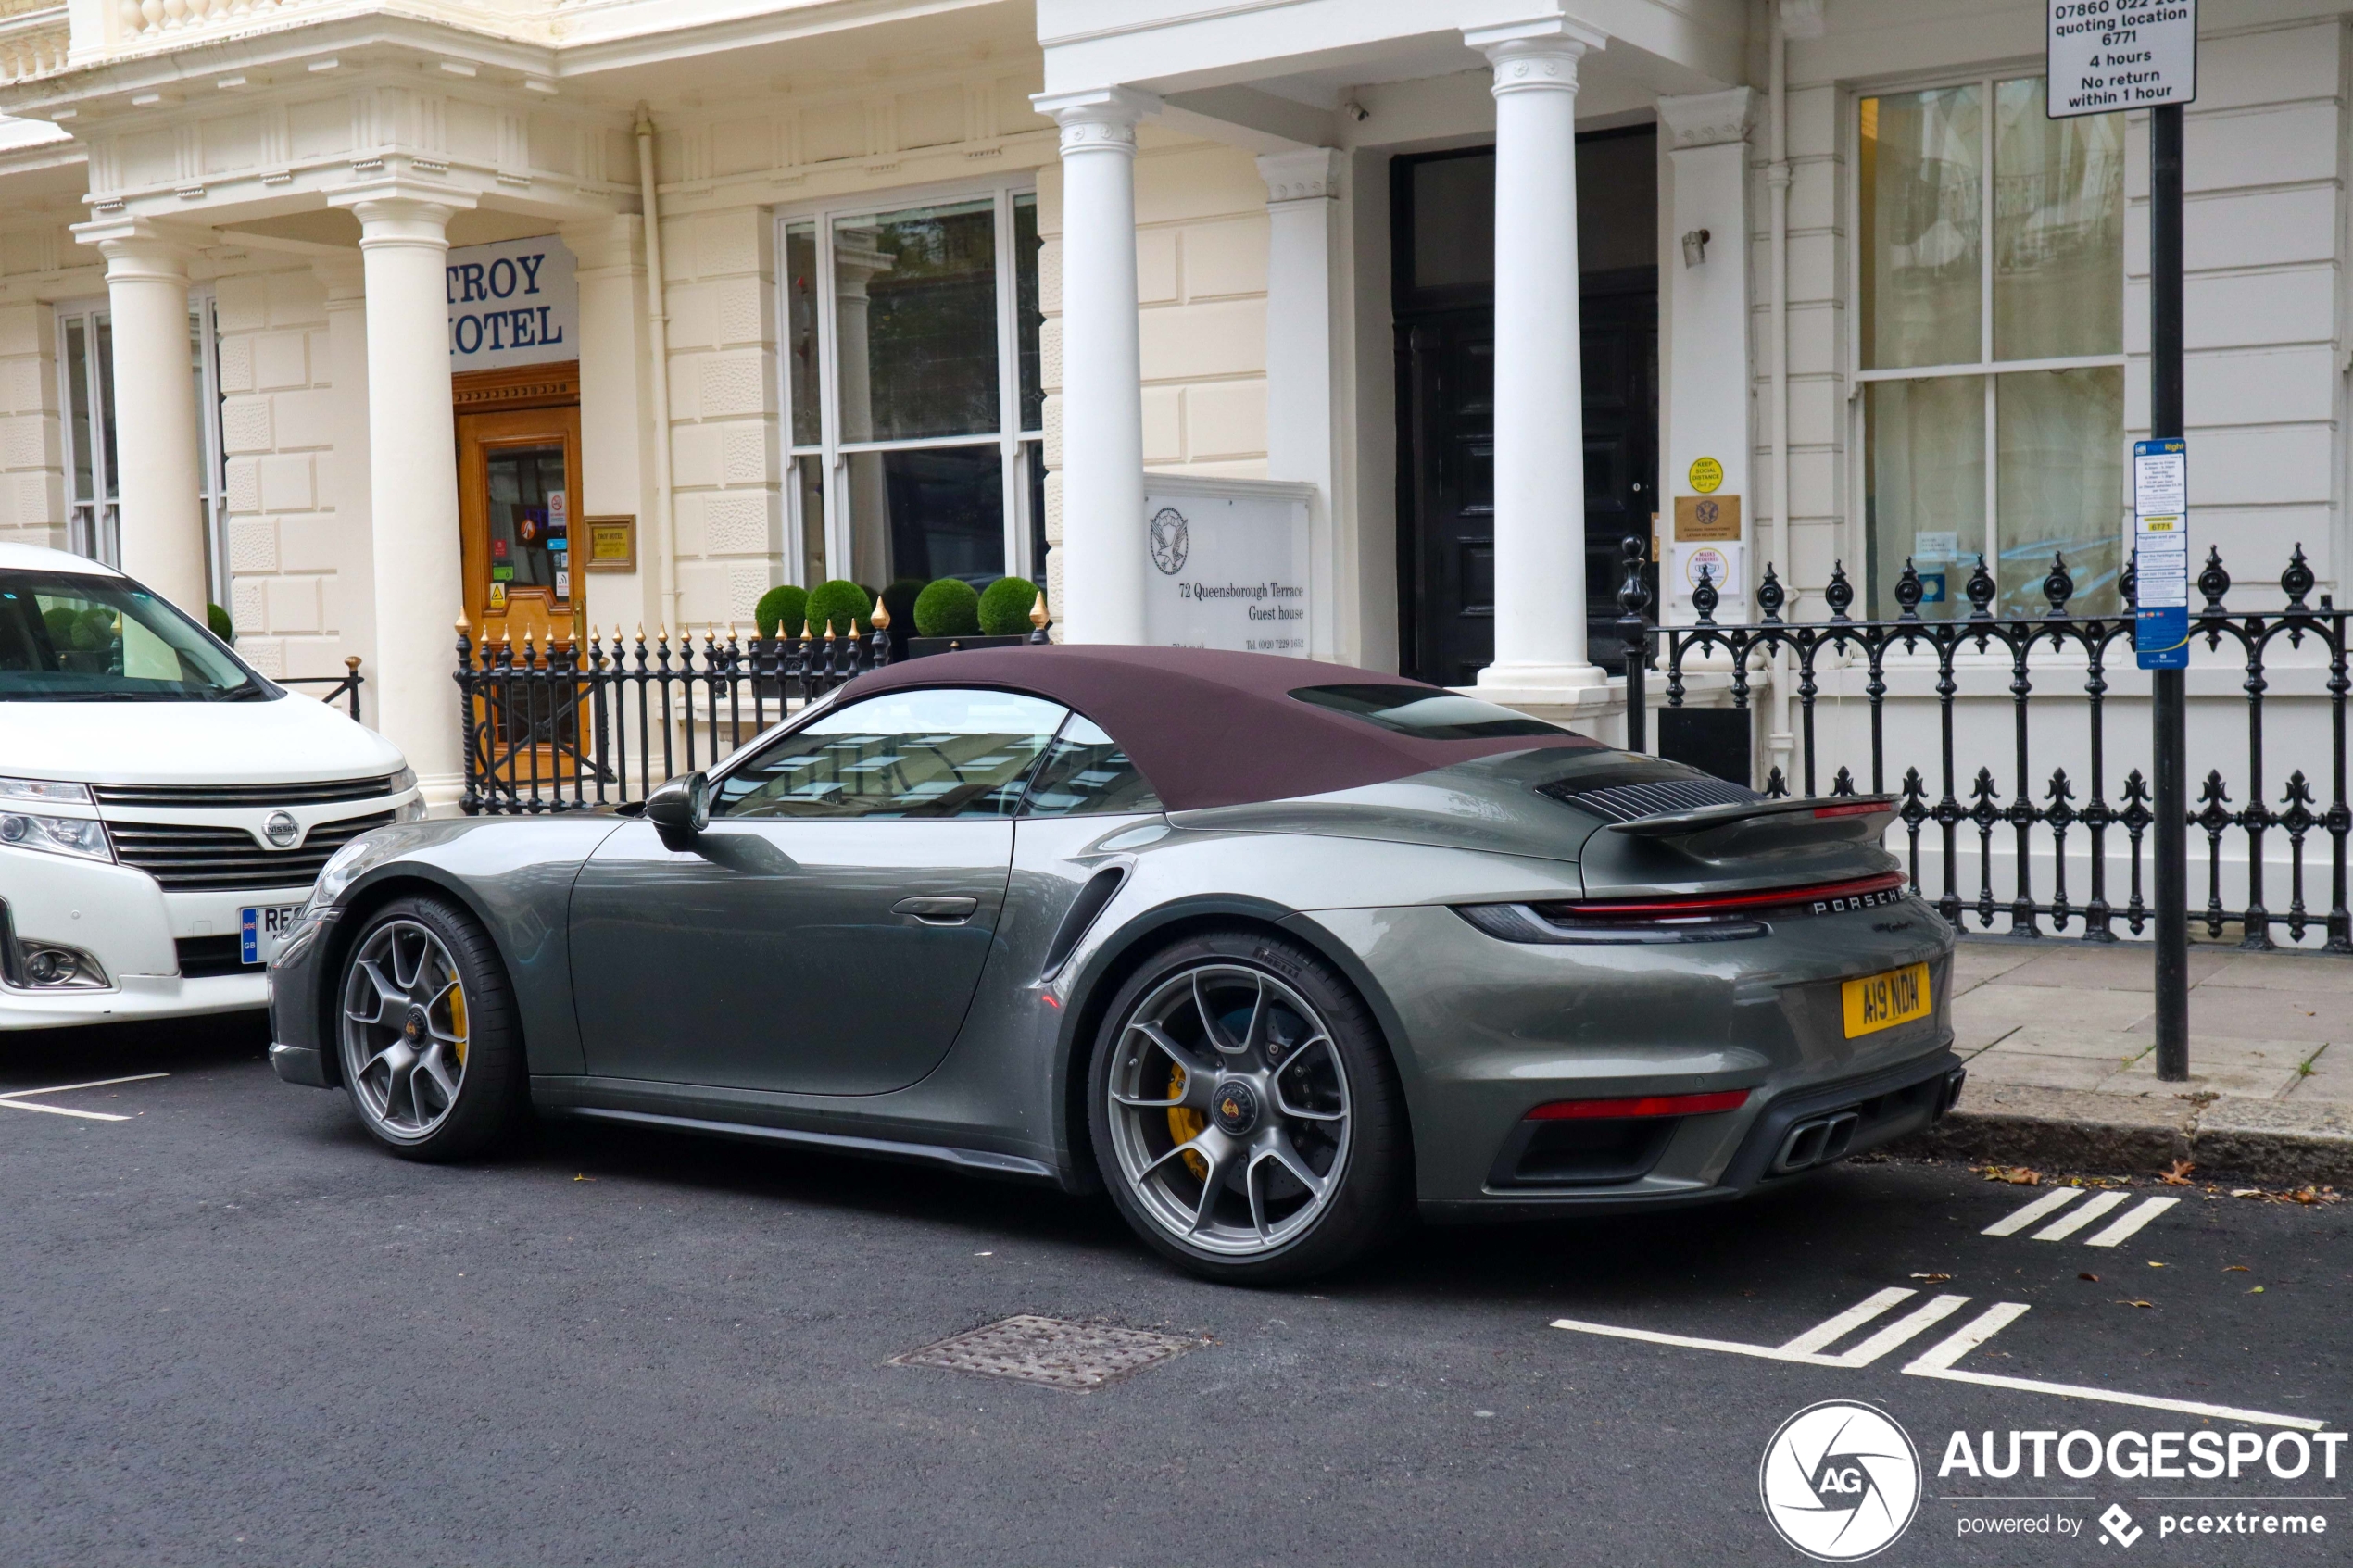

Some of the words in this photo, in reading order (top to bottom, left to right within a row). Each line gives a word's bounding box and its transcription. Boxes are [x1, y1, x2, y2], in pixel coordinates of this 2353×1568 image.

[2056, 0, 2109, 19] 07860
[2056, 19, 2116, 37] quoting
[2121, 8, 2187, 27] location
[2102, 30, 2136, 46] 6771
[2089, 55, 2100, 68] 4
[2107, 51, 2152, 66] hours
[2082, 77, 2103, 90] No
[2109, 71, 2160, 86] return
[2069, 92, 2117, 107] within
[2123, 89, 2129, 101] 1
[2135, 86, 2172, 99] hour
[446, 254, 545, 304] TROY
[448, 306, 563, 354] OTEL
[1179, 583, 1191, 598] 72
[1193, 583, 1268, 601] Queensborough
[1270, 582, 1304, 597] Terrace
[1248, 605, 1276, 621] Guest
[1278, 605, 1304, 620] house
[1276, 639, 1290, 649] 7229
[1290, 639, 1304, 649] 1652
[268, 824, 297, 833] NISSAN
[1813, 886, 1906, 915] PORSCHE
[1864, 980, 1888, 1024] A19
[1891, 972, 1919, 1017] NDN
